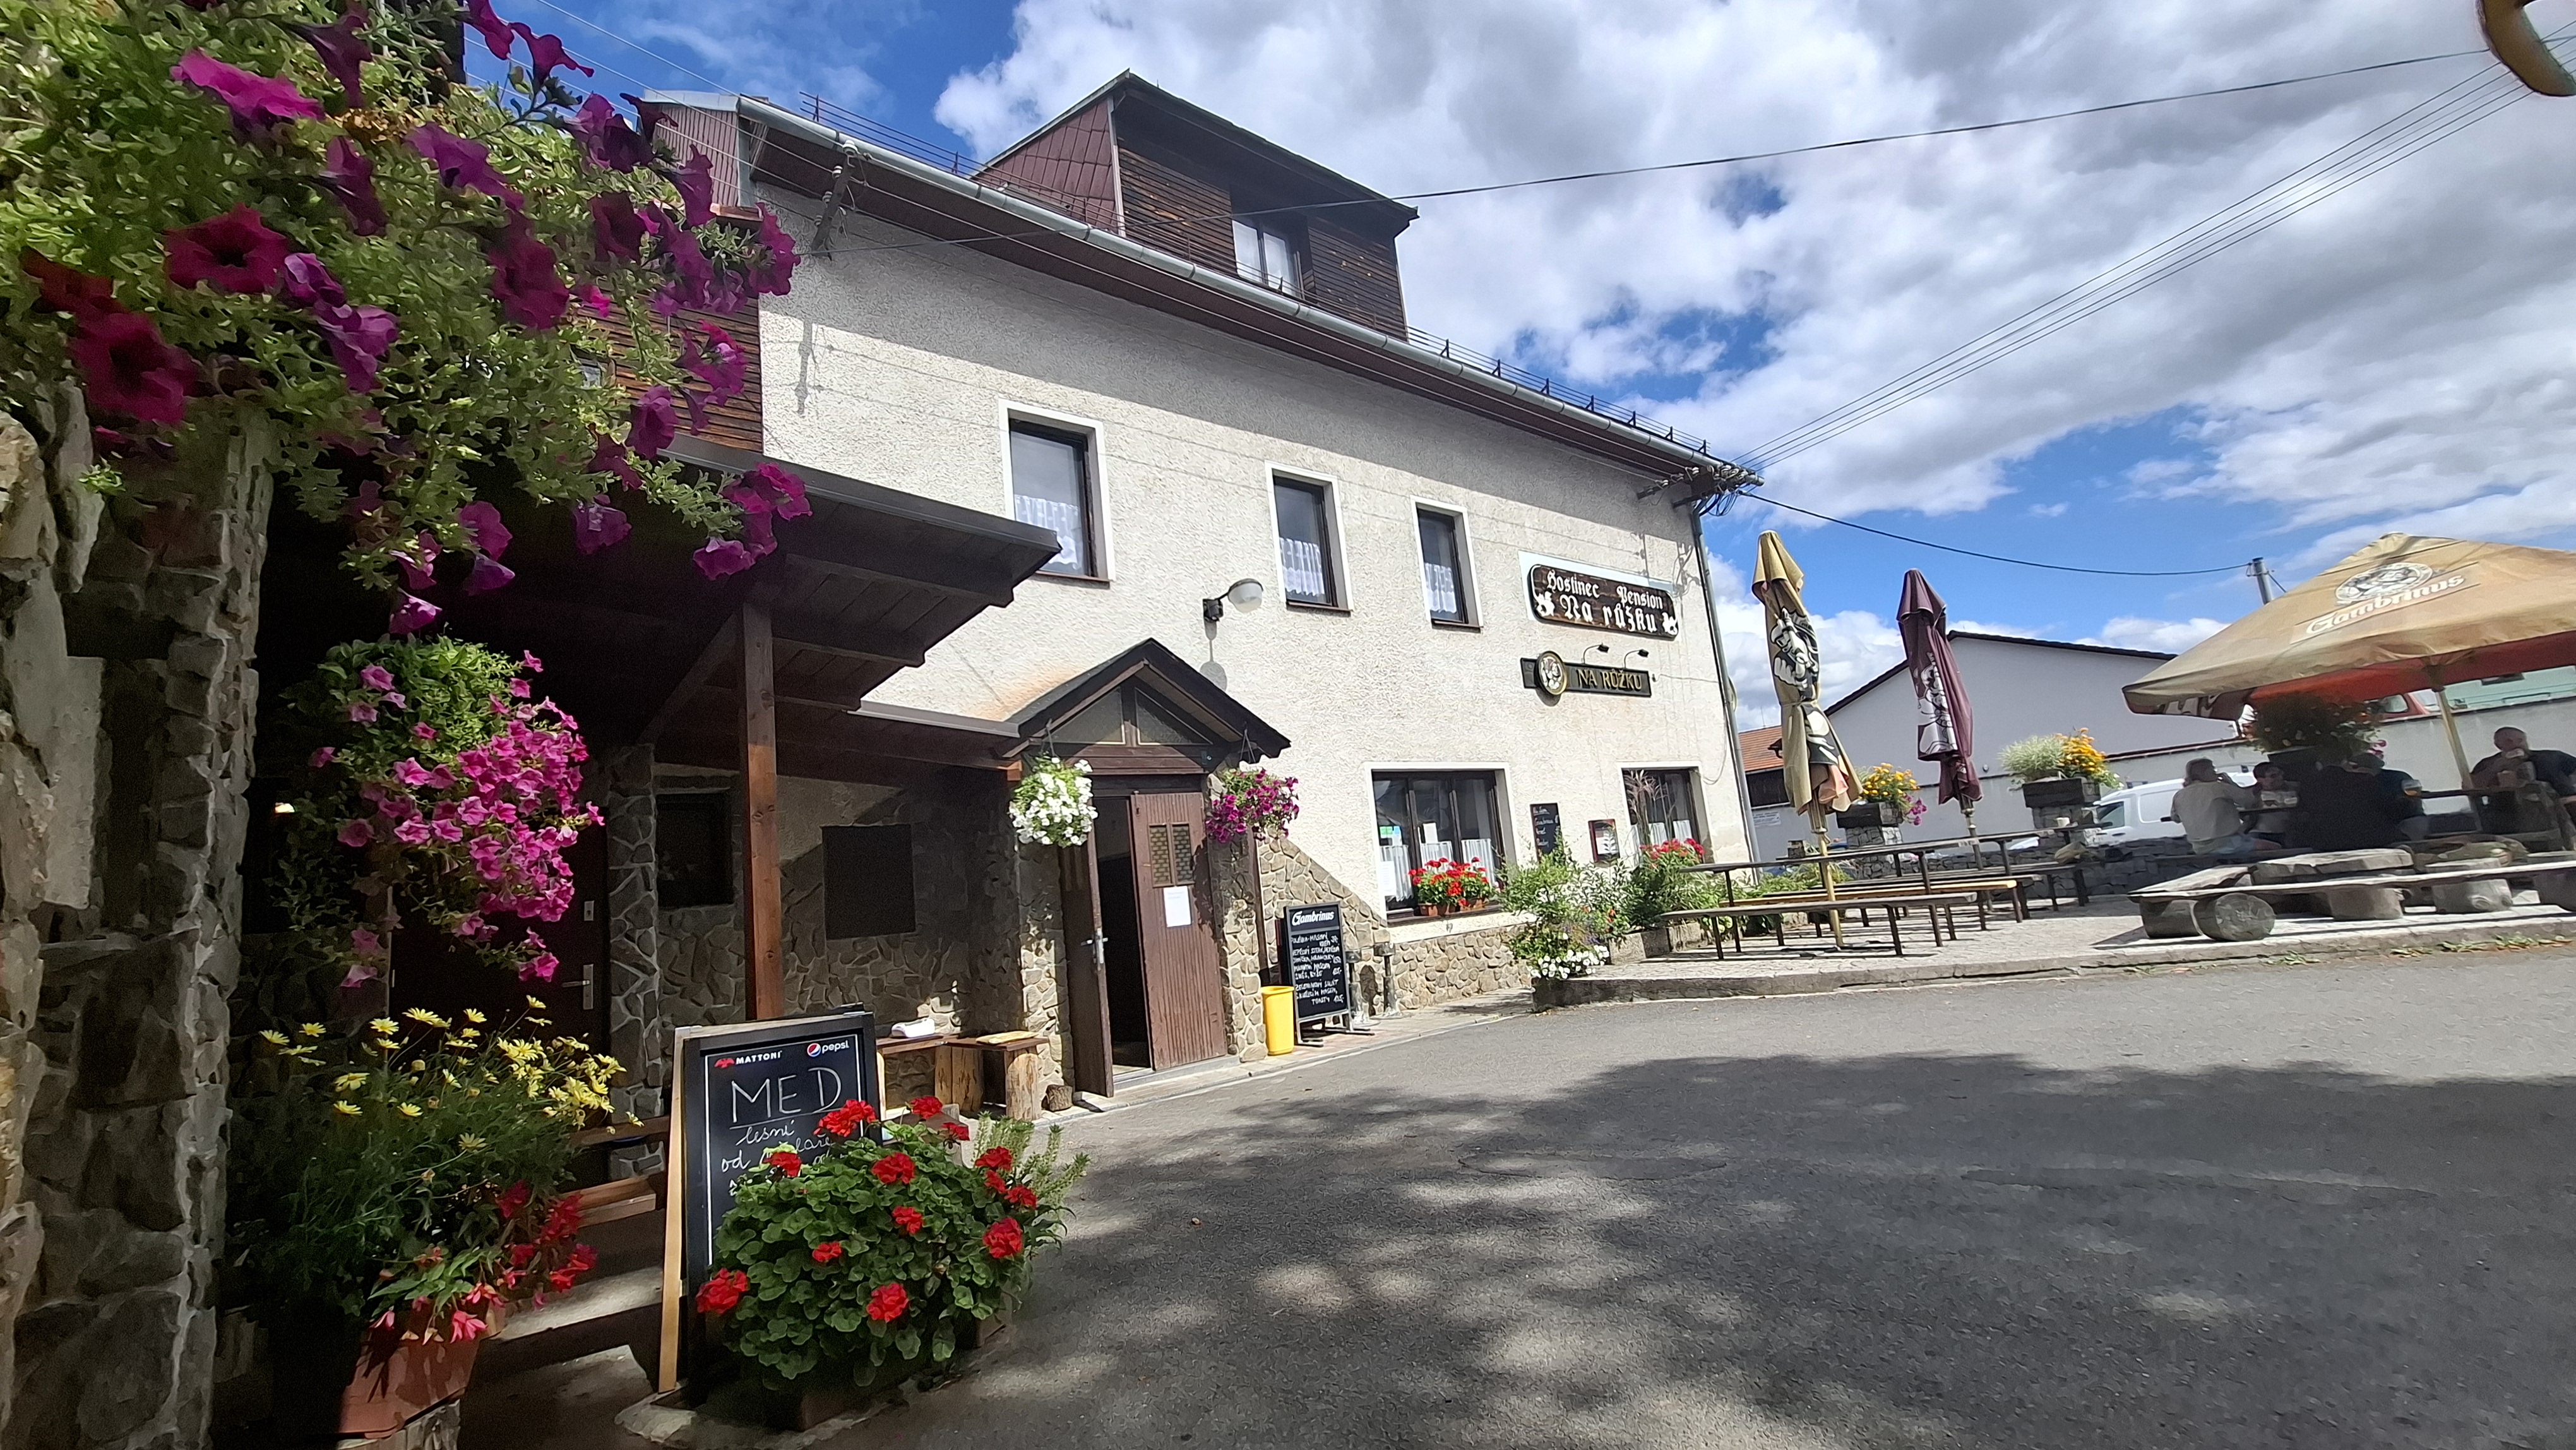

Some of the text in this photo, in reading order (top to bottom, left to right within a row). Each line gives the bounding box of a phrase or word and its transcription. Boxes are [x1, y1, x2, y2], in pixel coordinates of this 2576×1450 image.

[1547, 569, 1664, 610] Hostinec Pension
[1559, 594, 1594, 623] Na
[2306, 575, 2464, 633] Gambrinus
[1578, 669, 1642, 690] NA RŮŽKU
[1292, 911, 1335, 926] Gambrinus
[735, 1040, 850, 1065] MATTONI pepsi
[721, 1149, 751, 1172] od
